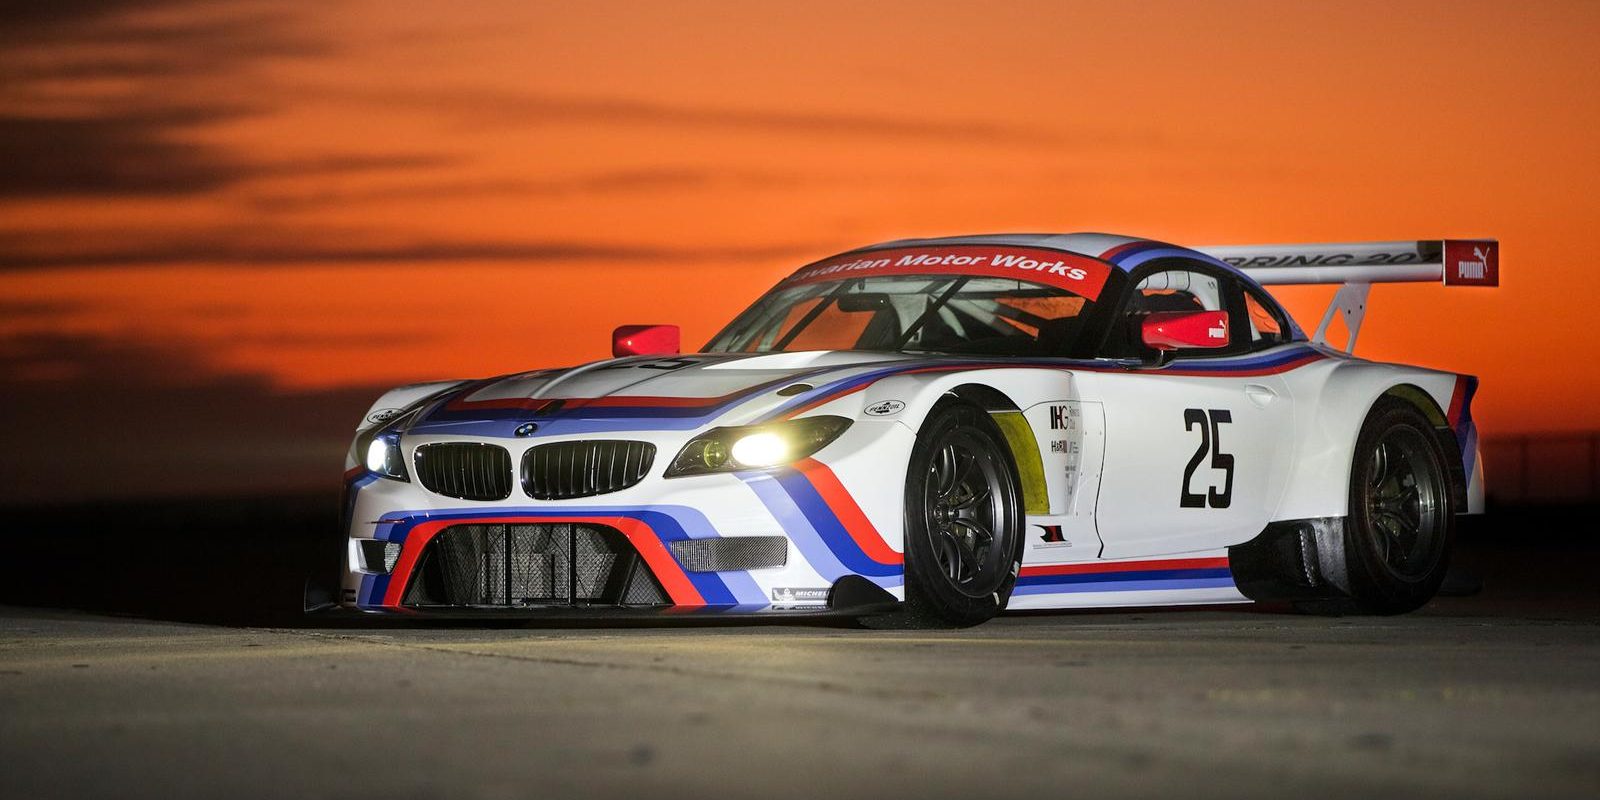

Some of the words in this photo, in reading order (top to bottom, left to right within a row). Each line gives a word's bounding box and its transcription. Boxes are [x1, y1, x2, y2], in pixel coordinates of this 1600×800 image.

[895, 254, 987, 267] Motor
[991, 254, 1088, 281] Works
[1458, 260, 1484, 279] PUMA
[1050, 405, 1069, 430] IHG
[1180, 408, 1235, 509] 25
